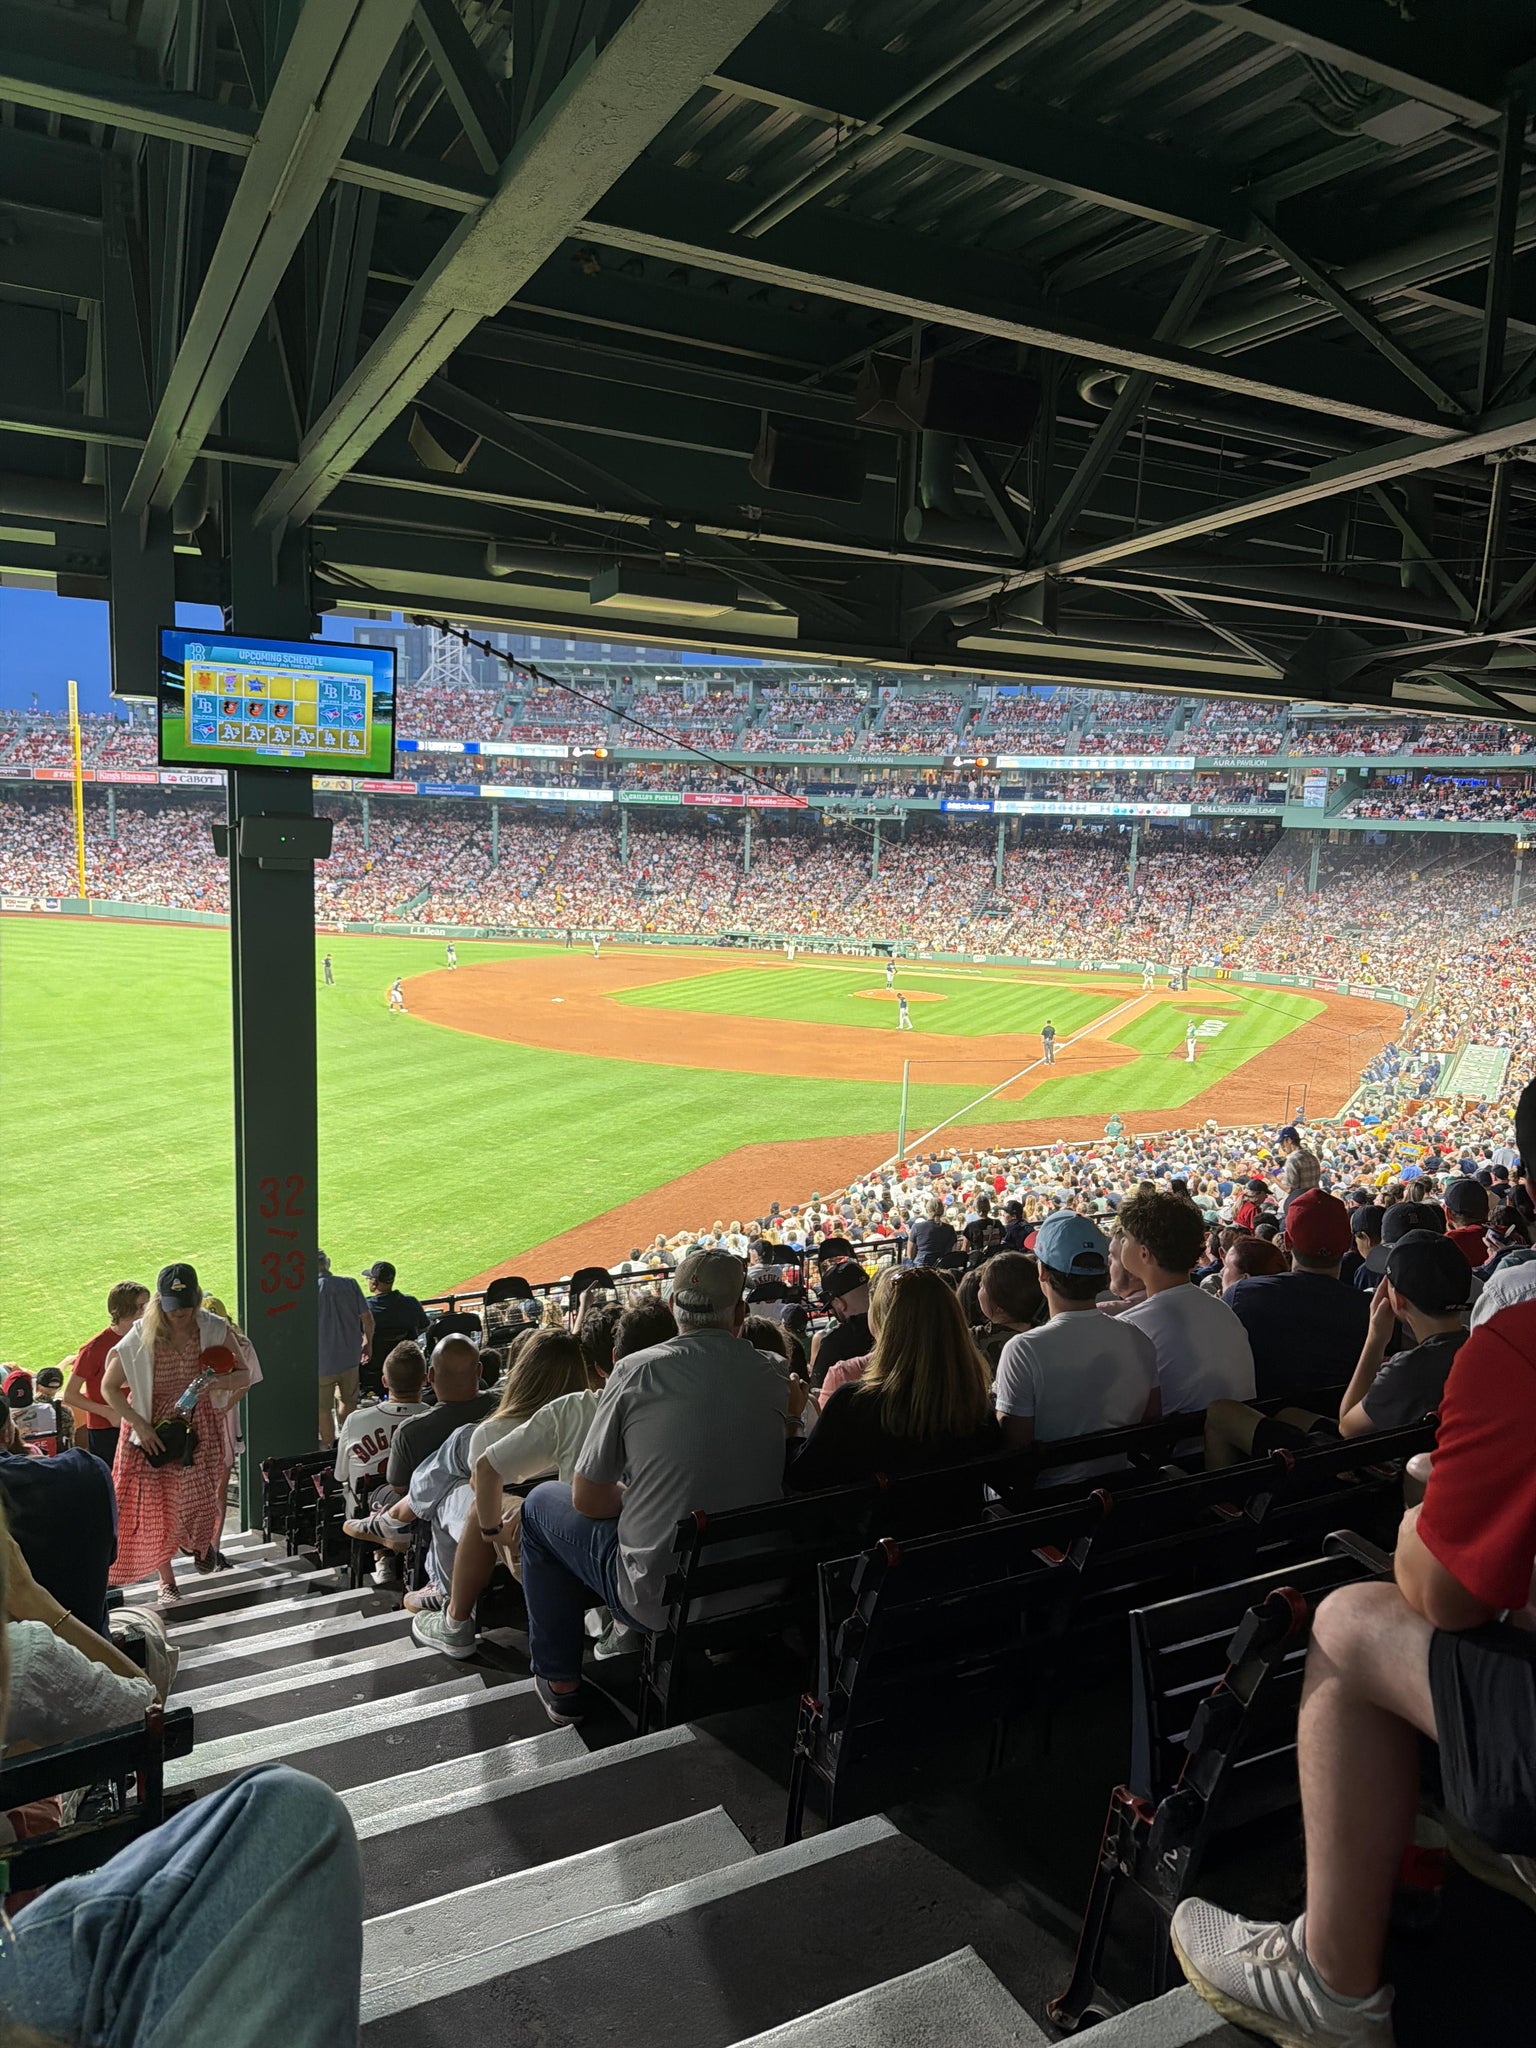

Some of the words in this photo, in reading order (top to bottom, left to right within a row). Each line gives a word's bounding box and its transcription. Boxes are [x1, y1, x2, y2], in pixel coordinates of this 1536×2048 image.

[239, 651, 282, 663] UPCOMING
[282, 654, 324, 666] SCHEDULE
[196, 697, 213, 714] TB
[867, 756, 893, 764] PAVILION
[52, 770, 76, 778] STIHL
[100, 771, 120, 781] King's
[121, 772, 154, 780] Hawaiian
[628, 793, 653, 801] GRILLO'S
[655, 794, 678, 802] PICKLES
[1217, 806, 1258, 814] Technologies
[410, 926, 445, 936] L.L.Bean
[259, 1173, 305, 1219] 32
[260, 1250, 306, 1294] 33
